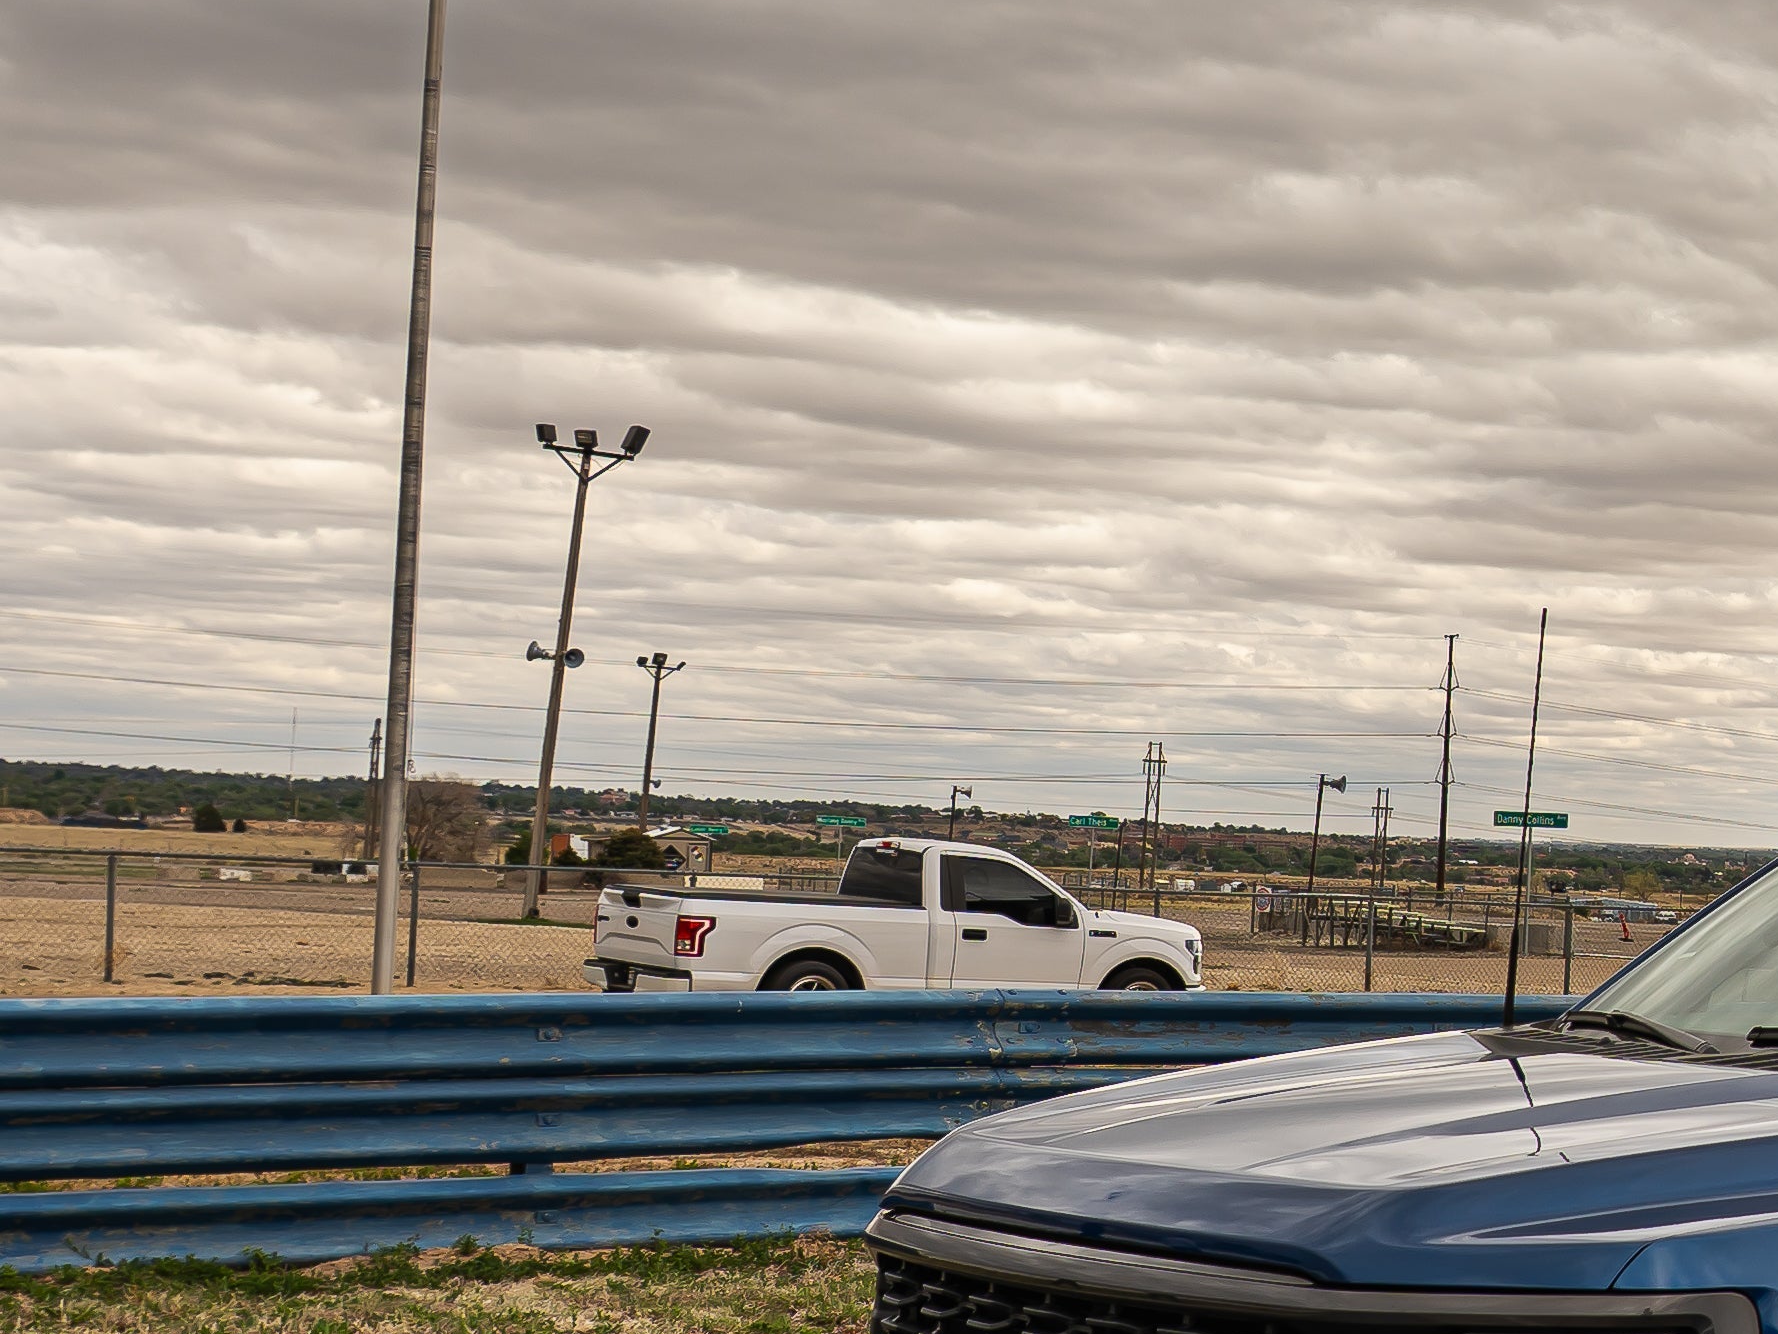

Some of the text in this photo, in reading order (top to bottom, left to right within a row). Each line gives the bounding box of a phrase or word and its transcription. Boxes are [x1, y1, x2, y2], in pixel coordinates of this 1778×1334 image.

[1070, 816, 1086, 825] Carl
[1497, 813, 1524, 825] Danny
[1526, 814, 1555, 826] Collins
